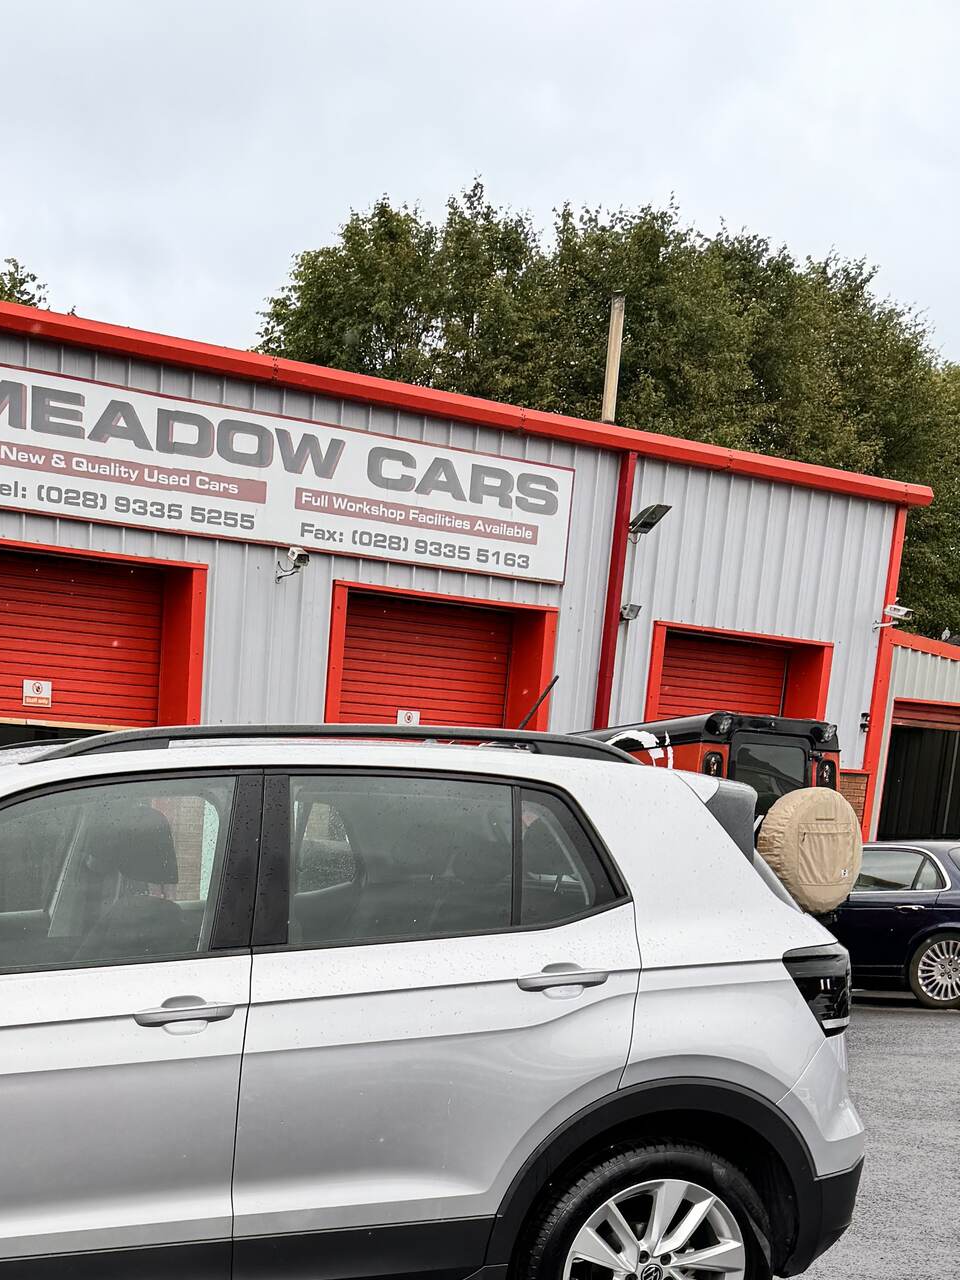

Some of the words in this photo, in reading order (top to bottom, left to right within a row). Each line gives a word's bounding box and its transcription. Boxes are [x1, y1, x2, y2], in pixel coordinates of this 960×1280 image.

[0, 445, 46, 465] New
[51, 453, 66, 468] &
[71, 456, 139, 482] Quality
[144, 468, 190, 487] Used
[195, 475, 239, 494] Cars
[367, 446, 559, 516] CARS
[37, 484, 107, 510] (028)
[114, 496, 182, 520] 9335
[190, 506, 255, 530] 5255
[301, 492, 328, 508] Full
[333, 497, 405, 522] Workshop
[408, 509, 470, 530] Facilities
[474, 519, 533, 540] Available
[300, 522, 344, 544] Fax:
[351, 529, 408, 552] (028)
[414, 539, 470, 561] 9335
[476, 548, 530, 570] 5163
